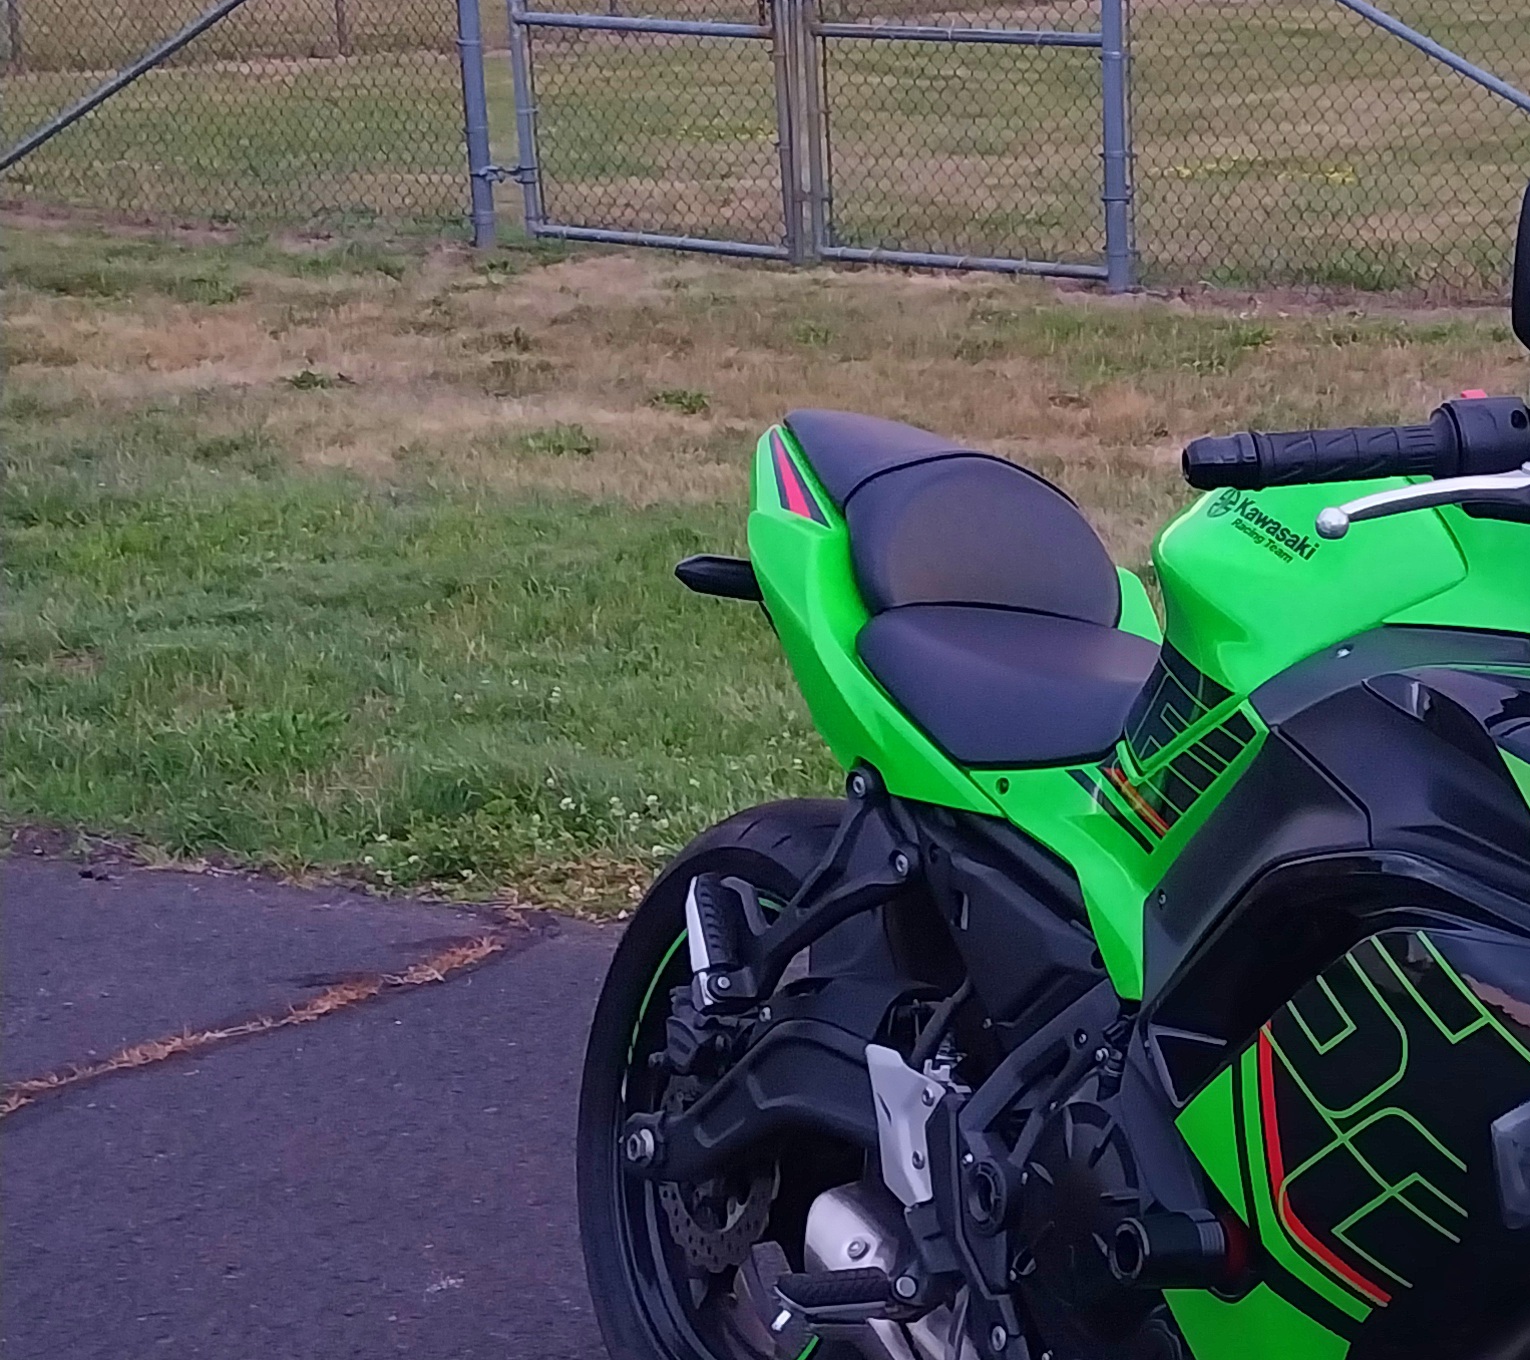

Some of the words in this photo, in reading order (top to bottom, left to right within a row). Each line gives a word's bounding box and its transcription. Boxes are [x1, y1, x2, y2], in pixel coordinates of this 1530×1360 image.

[1231, 518, 1266, 544] Racing
[1264, 538, 1293, 563] Team
[1234, 497, 1320, 560] Kawasaki
